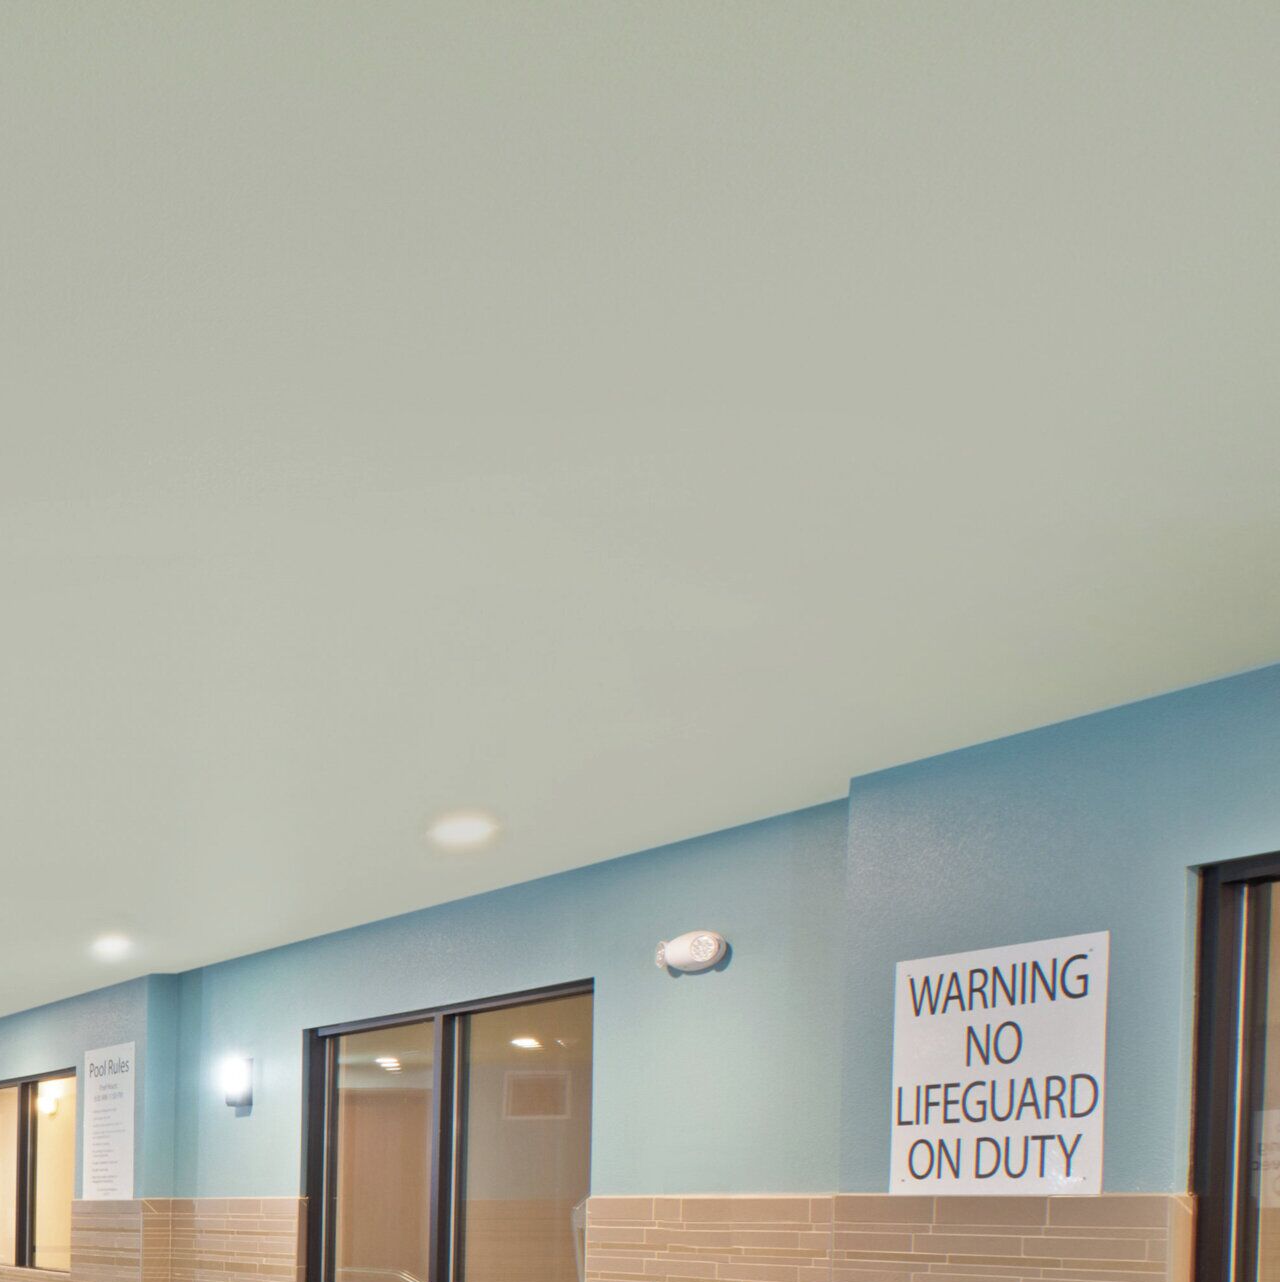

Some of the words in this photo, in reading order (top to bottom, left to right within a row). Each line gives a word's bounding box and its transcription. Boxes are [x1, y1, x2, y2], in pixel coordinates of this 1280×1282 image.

[909, 953, 1089, 1017] WARNING
[965, 1020, 1023, 1067] NO
[89, 1060, 106, 1078] Pool
[108, 1057, 129, 1075] Rules
[897, 1073, 1099, 1126] LIFEGUARD
[908, 1138, 961, 1180] ON
[974, 1133, 1082, 1179] DUTY
